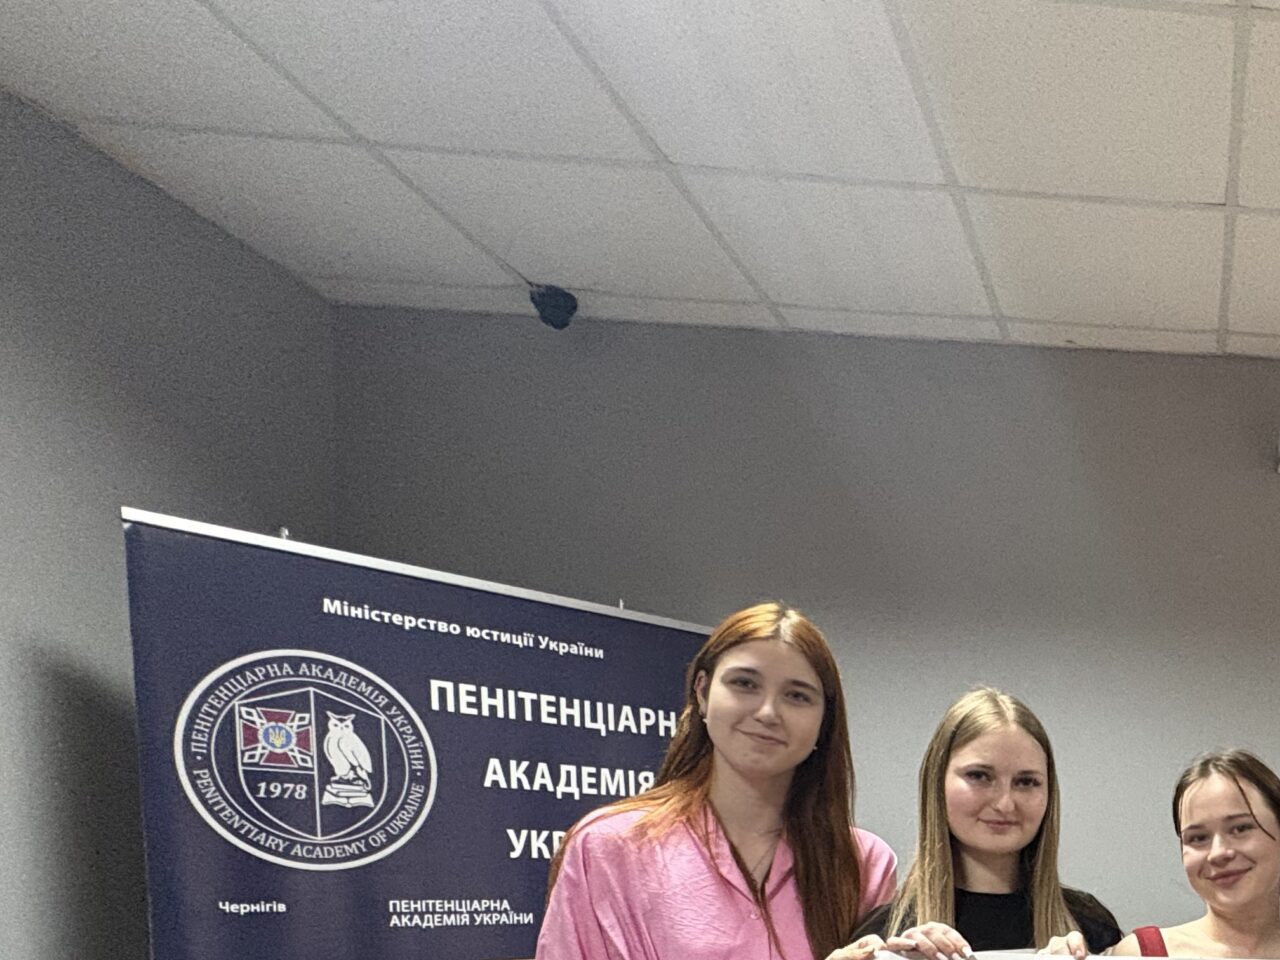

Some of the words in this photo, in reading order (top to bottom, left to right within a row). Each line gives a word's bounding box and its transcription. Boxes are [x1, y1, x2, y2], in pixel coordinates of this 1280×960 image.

[322, 597, 461, 635] Міністерство
[466, 625, 534, 648] юстиції
[538, 635, 605, 659] України
[191, 663, 294, 754] ПЕНІТЕНЦІАРНА
[298, 662, 389, 708] АКАДЕМІЯ
[386, 705, 425, 770] УКРАЇНИ
[430, 679, 678, 738] ПЕНІТЕНЦІАРН
[256, 782, 308, 800] 1978
[483, 758, 656, 800] АКАДЕМІЯ
[193, 768, 288, 852] PENITENTIARY
[291, 841, 366, 859] ACADEMY
[368, 830, 389, 847] OF
[385, 783, 425, 838] UKRAINE
[507, 828, 566, 859] УКР
[218, 900, 287, 916] Чернігів
[389, 900, 510, 913] ПЕНІТЕНЦІАРНА
[389, 914, 470, 928] АКАДЕМІЯ
[474, 911, 534, 925] УКРАЇНИ
